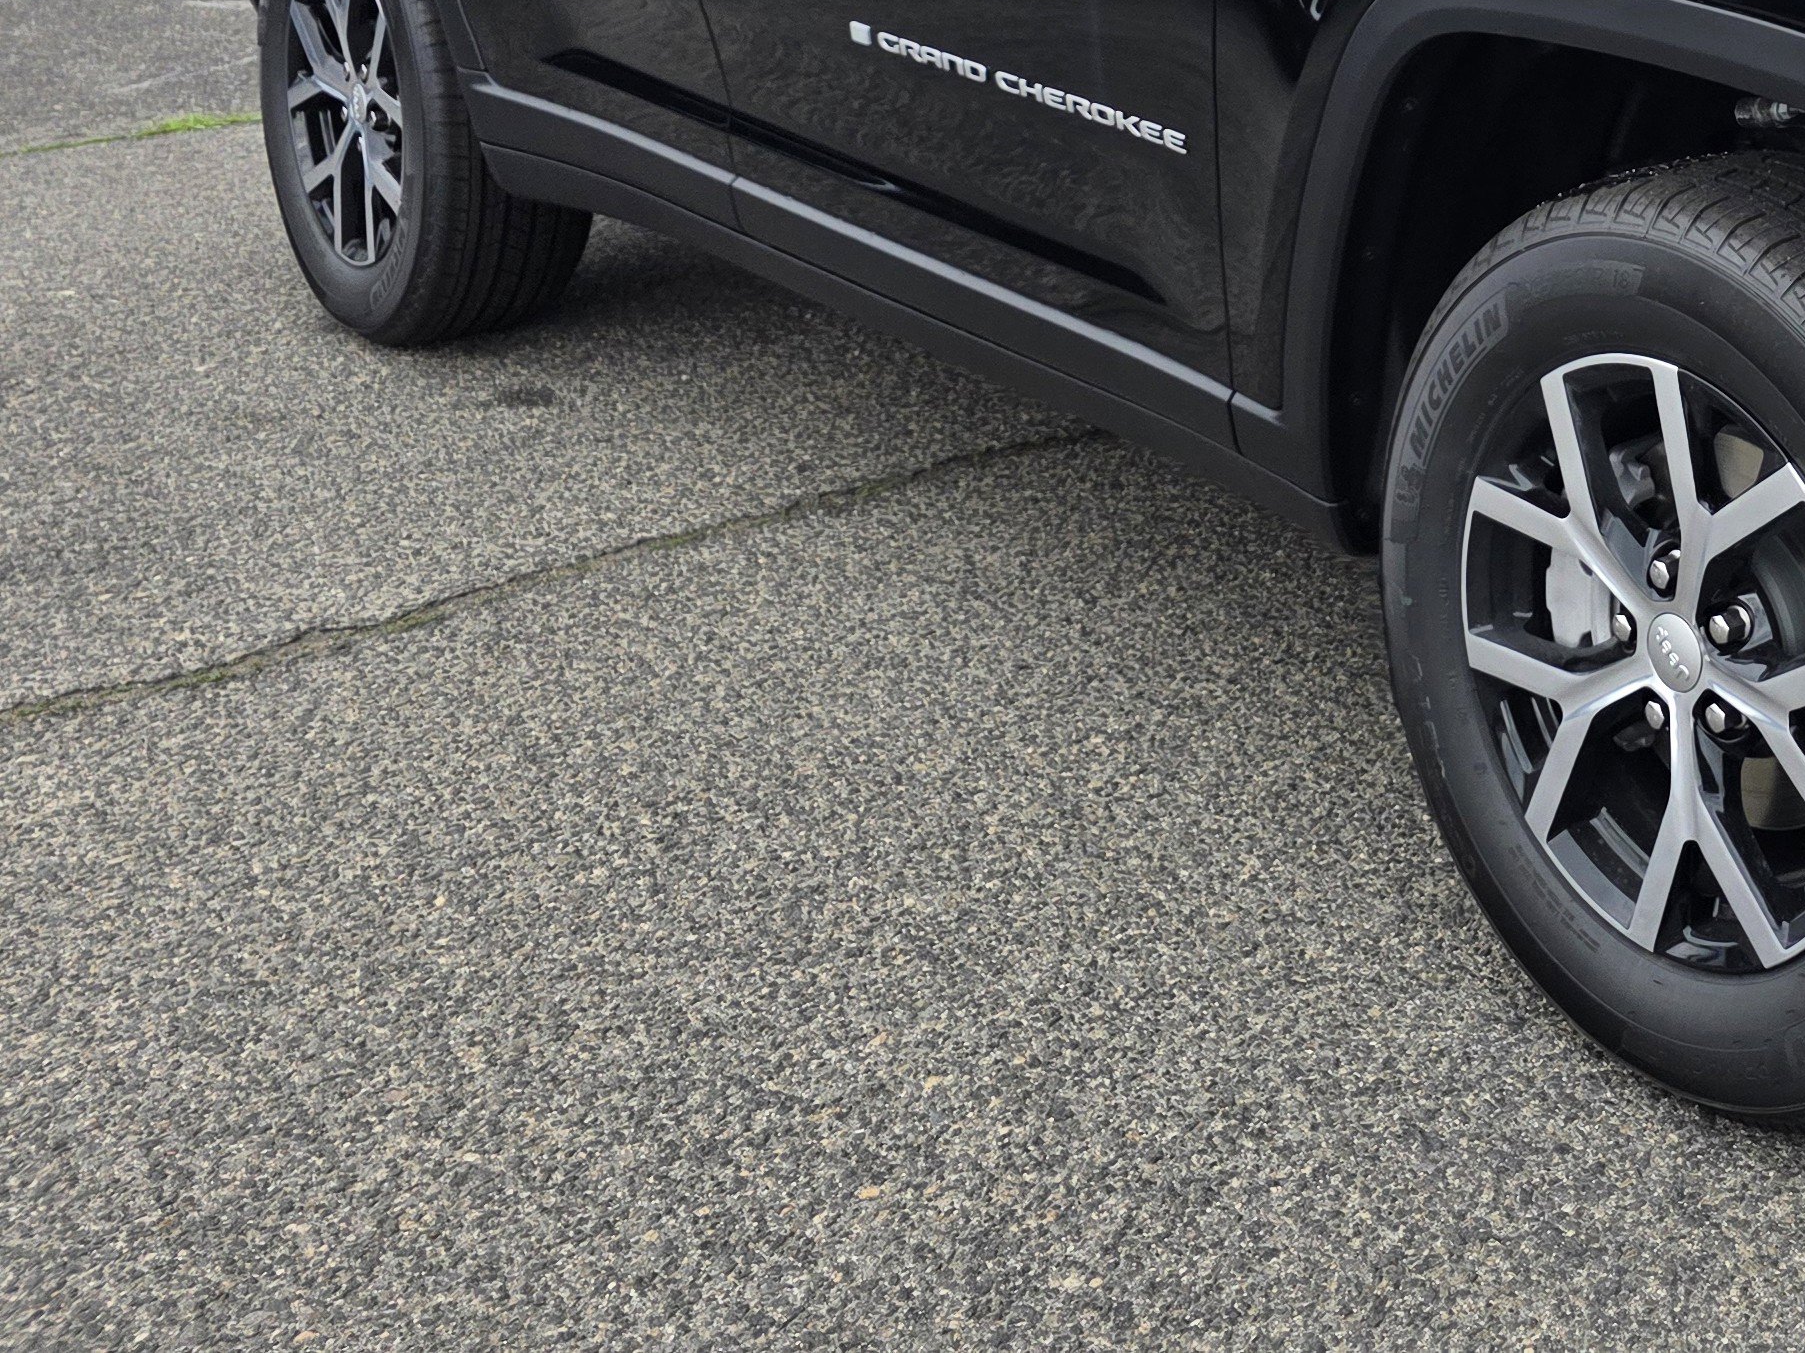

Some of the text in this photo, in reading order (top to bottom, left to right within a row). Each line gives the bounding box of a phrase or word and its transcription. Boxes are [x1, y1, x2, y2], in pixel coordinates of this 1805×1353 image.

[876, 30, 1188, 155] GRAND CHEROKEE
[1409, 302, 1505, 458] MICHELIN
[1655, 626, 1690, 681] Jeep
